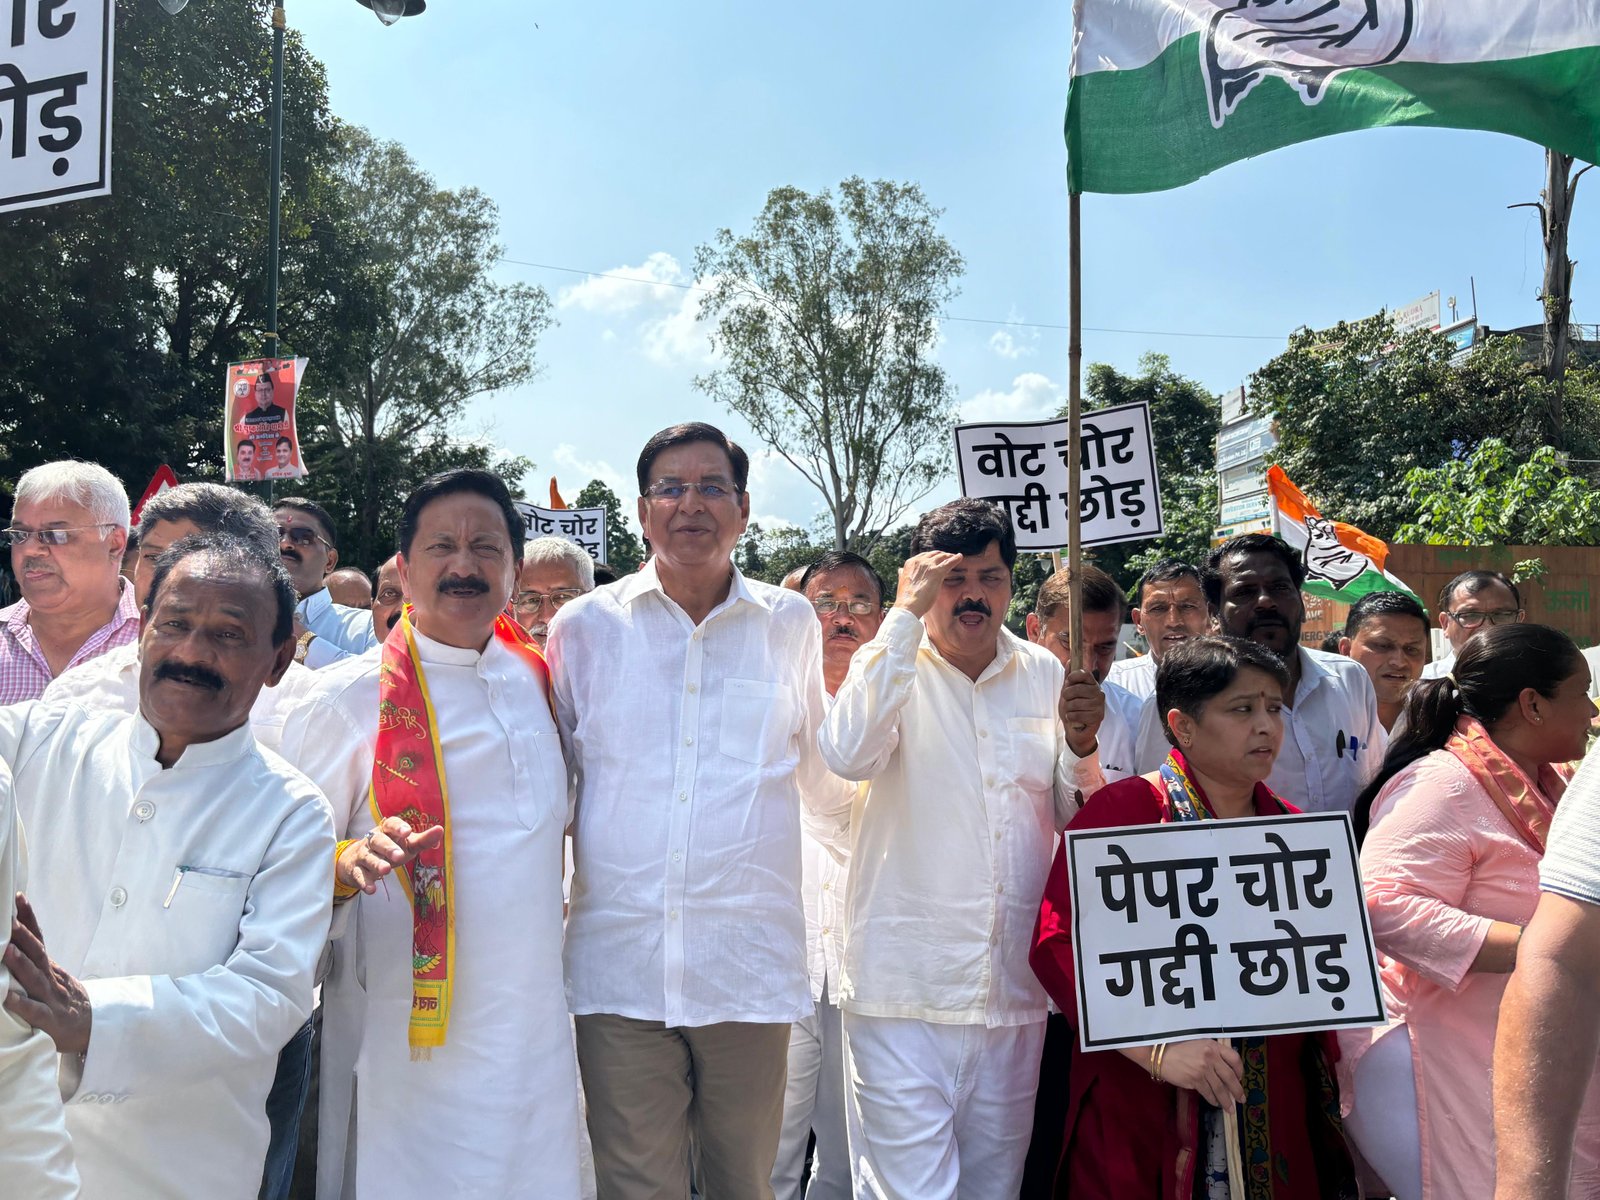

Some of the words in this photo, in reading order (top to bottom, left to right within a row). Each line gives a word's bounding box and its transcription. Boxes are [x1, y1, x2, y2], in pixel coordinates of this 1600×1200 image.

[0, 63, 88, 176] ोड़
[971, 432, 1046, 478] वोट
[1054, 423, 1134, 471] चोर
[559, 514, 598, 536] चोर
[1059, 475, 1146, 528] छोड़
[1095, 844, 1219, 923] पेपर
[1229, 832, 1333, 912] चोर
[1098, 923, 1218, 1009] गद्दी
[1230, 919, 1351, 1011] छोड़
